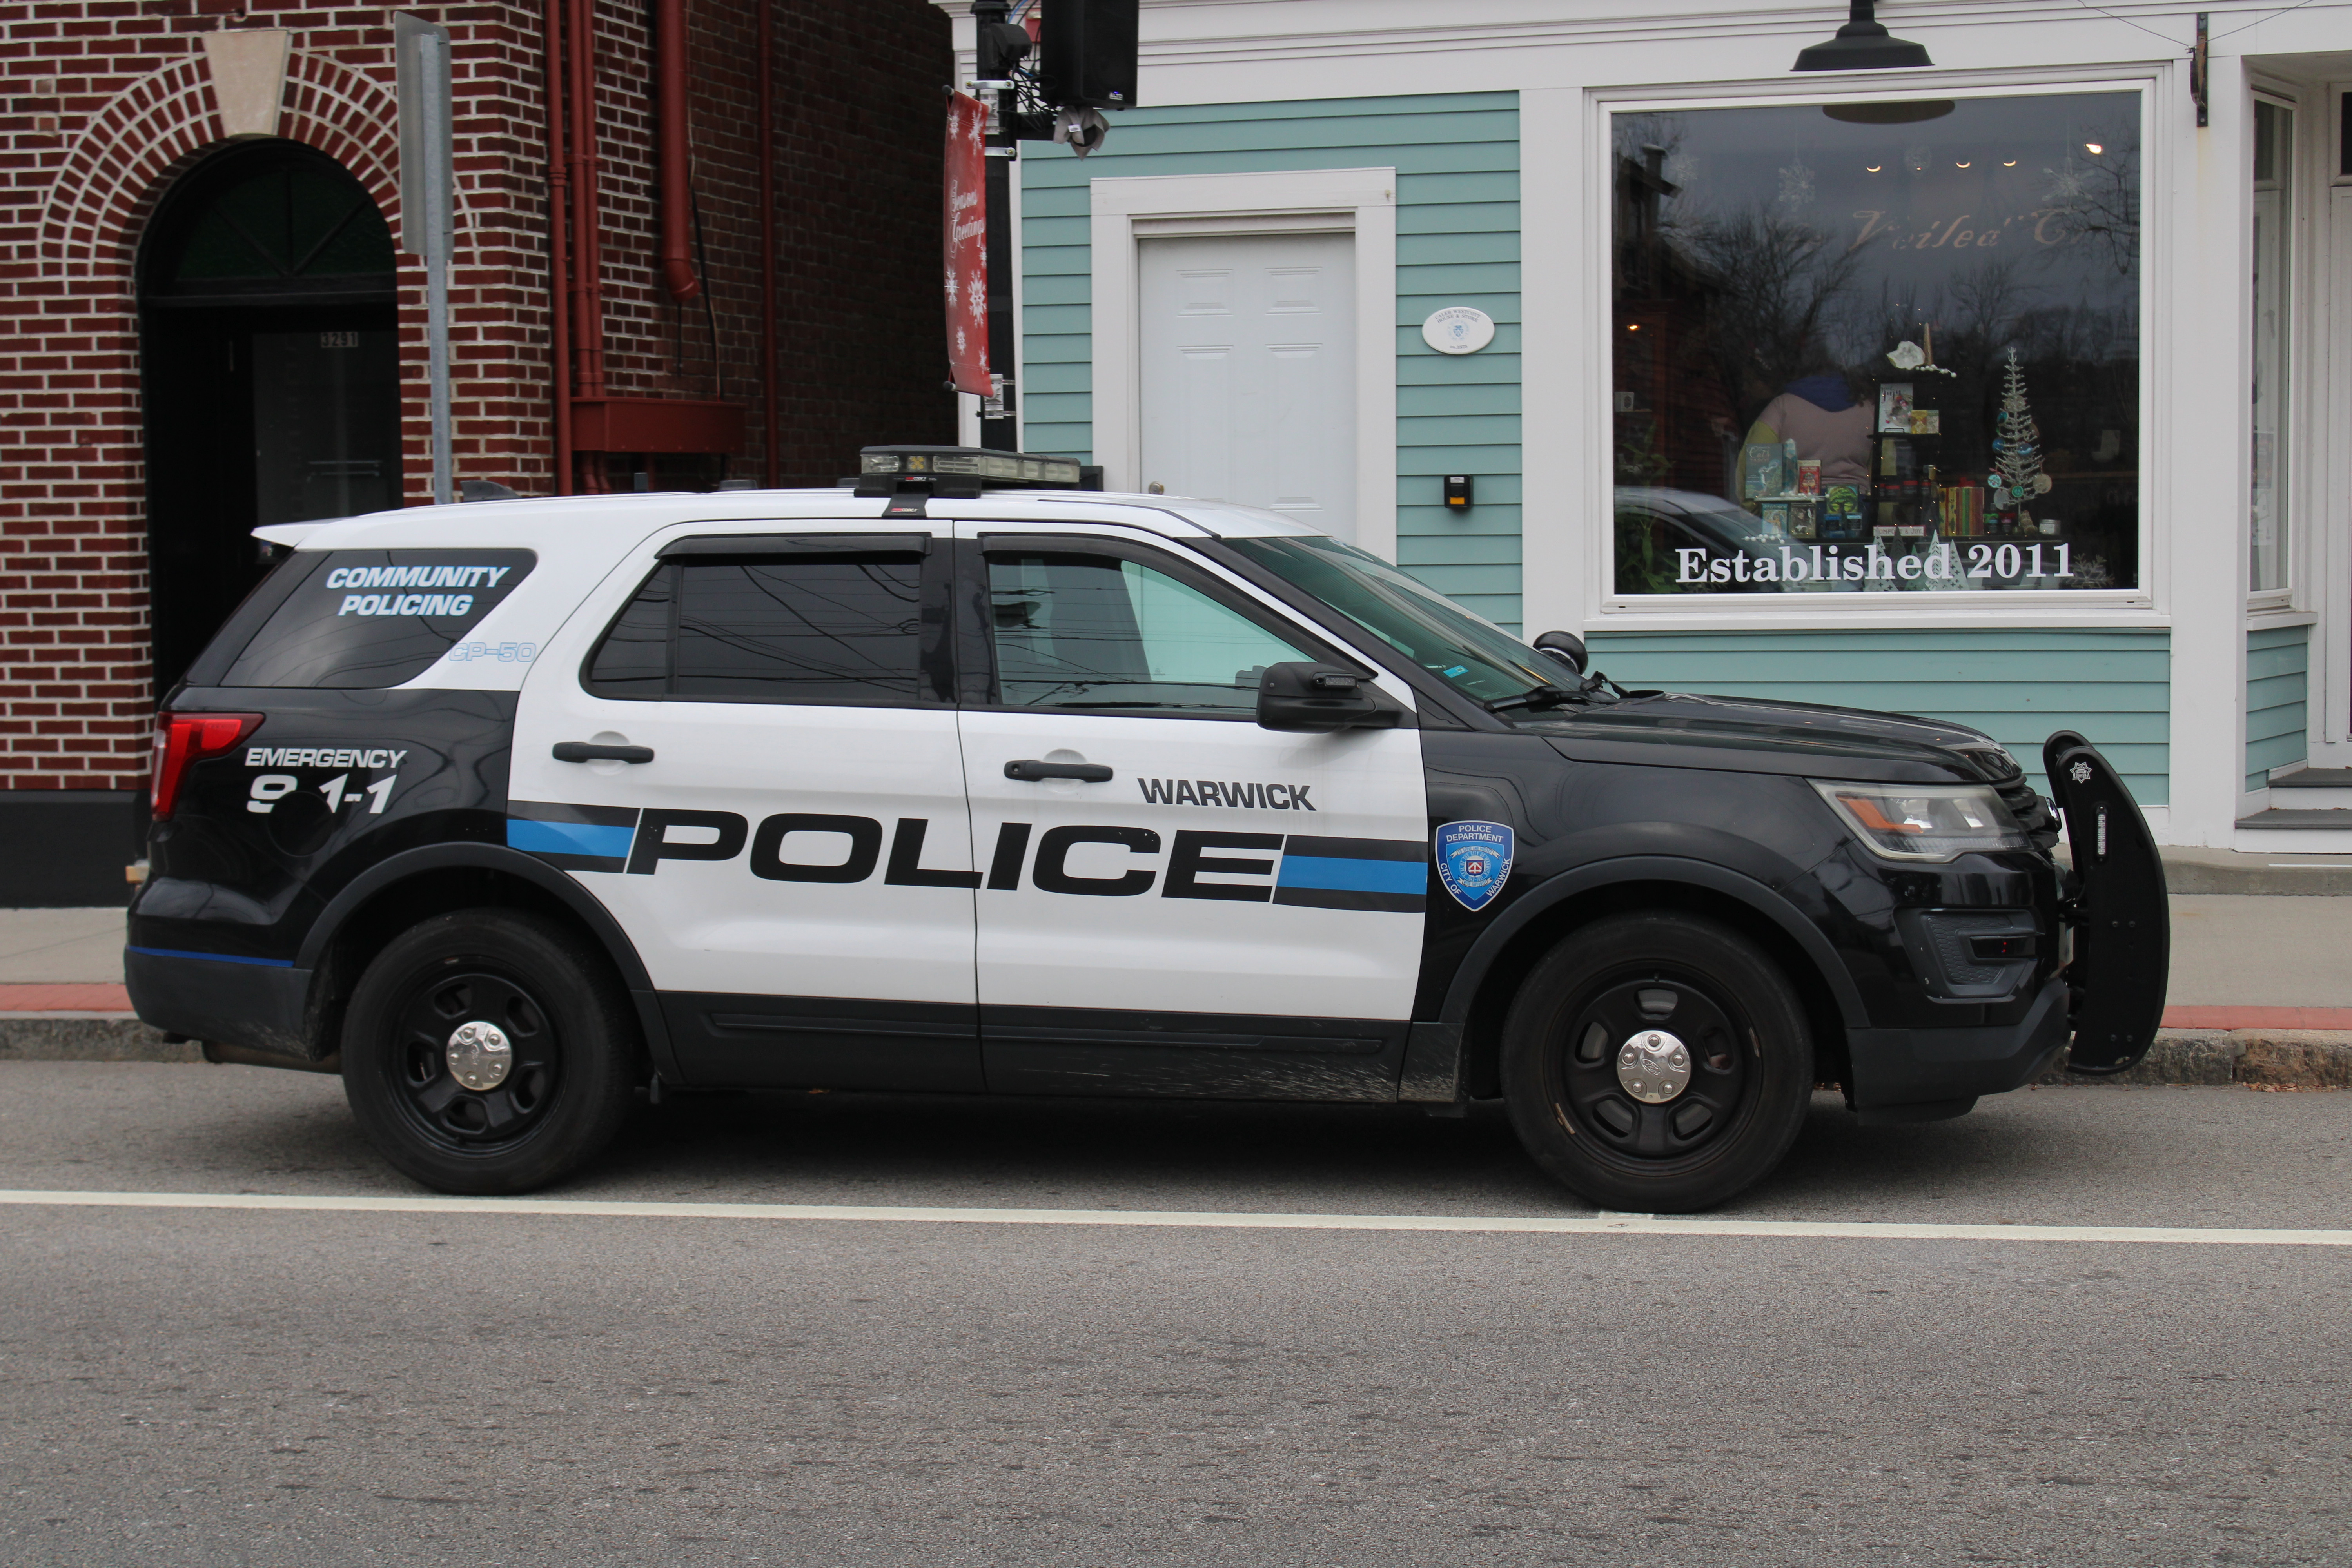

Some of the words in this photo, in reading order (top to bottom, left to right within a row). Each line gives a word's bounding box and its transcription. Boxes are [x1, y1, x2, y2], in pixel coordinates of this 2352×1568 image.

[950, 212, 985, 258] Greetings
[322, 332, 355, 347] 3291
[1675, 544, 1953, 583] Established
[1967, 543, 2074, 579] 2011
[326, 566, 511, 589] COMMUNITY
[338, 594, 474, 616] POLICING
[449, 642, 537, 662] CP-50
[245, 748, 408, 768] EMERGENCY
[1137, 777, 1318, 811] WARWICK
[1446, 833, 1504, 842] DEPARTMENT
[1459, 825, 1492, 833] POLICE
[626, 807, 1285, 903] POLICE
[1440, 863, 1453, 882] CITY
[1450, 884, 1462, 895] OF
[1486, 858, 1510, 897] WARWICK
[1644, 1062, 1661, 1076] Ford
